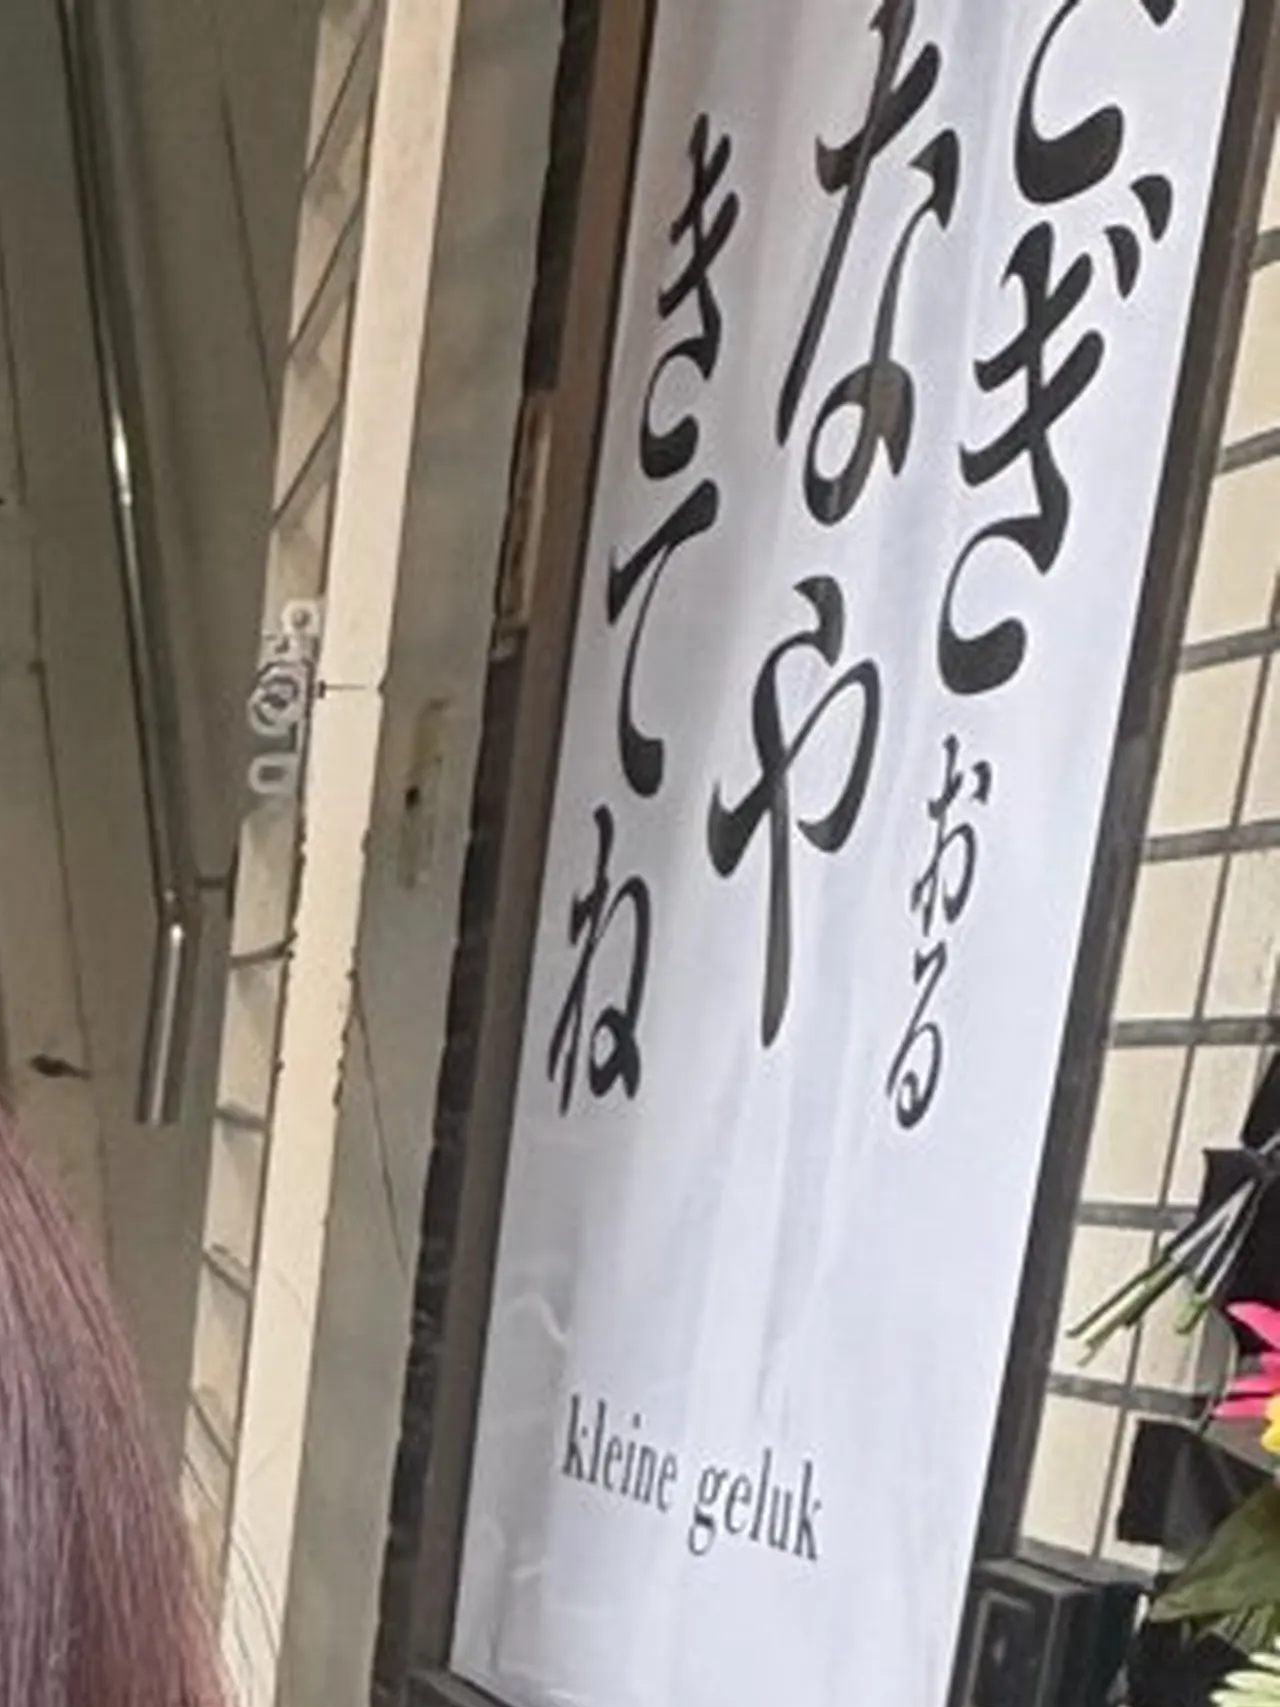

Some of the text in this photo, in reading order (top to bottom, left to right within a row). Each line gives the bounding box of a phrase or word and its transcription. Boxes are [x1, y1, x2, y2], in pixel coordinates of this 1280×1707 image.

[546, 113, 739, 1117] きてね
[561, 1393, 822, 1561] kleine geluk
